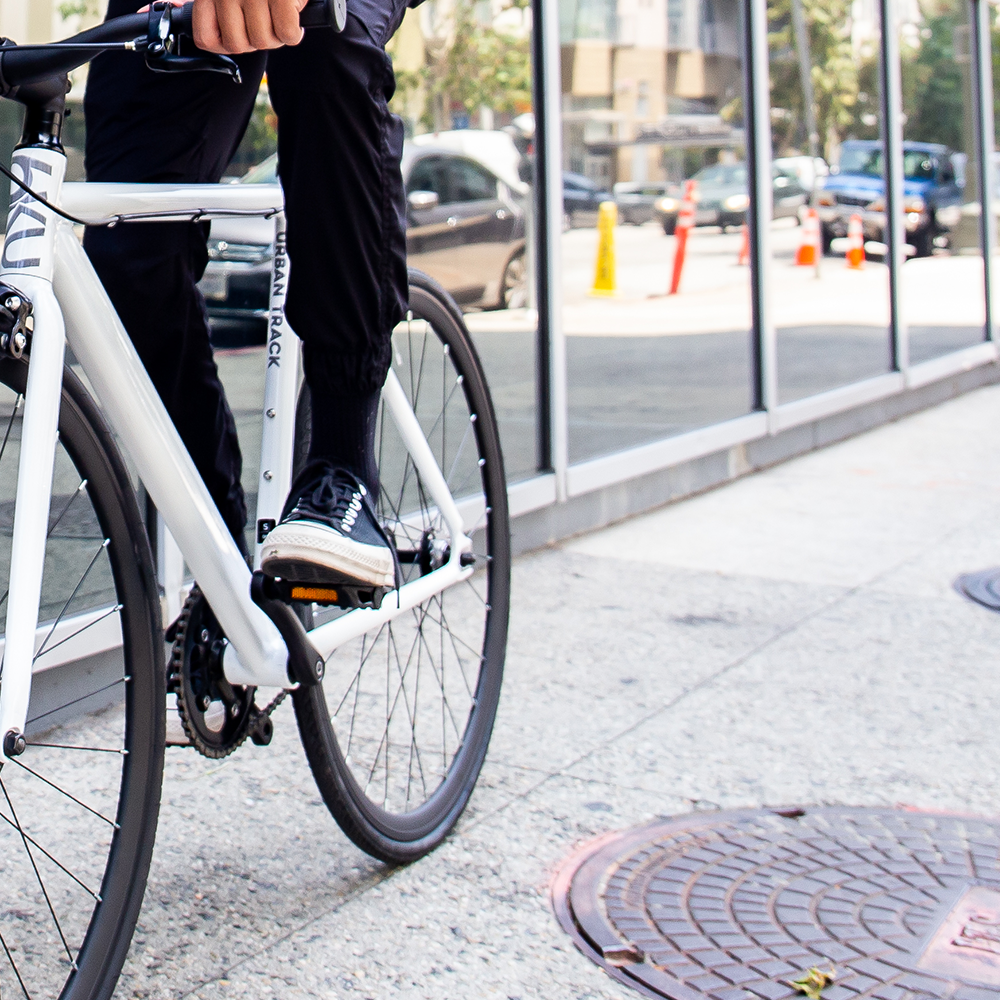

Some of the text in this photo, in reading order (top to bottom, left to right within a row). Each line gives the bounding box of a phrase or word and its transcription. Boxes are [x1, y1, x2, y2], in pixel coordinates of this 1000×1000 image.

[268, 232, 286, 368] URBAN TRACK
[262, 522, 269, 530] S
